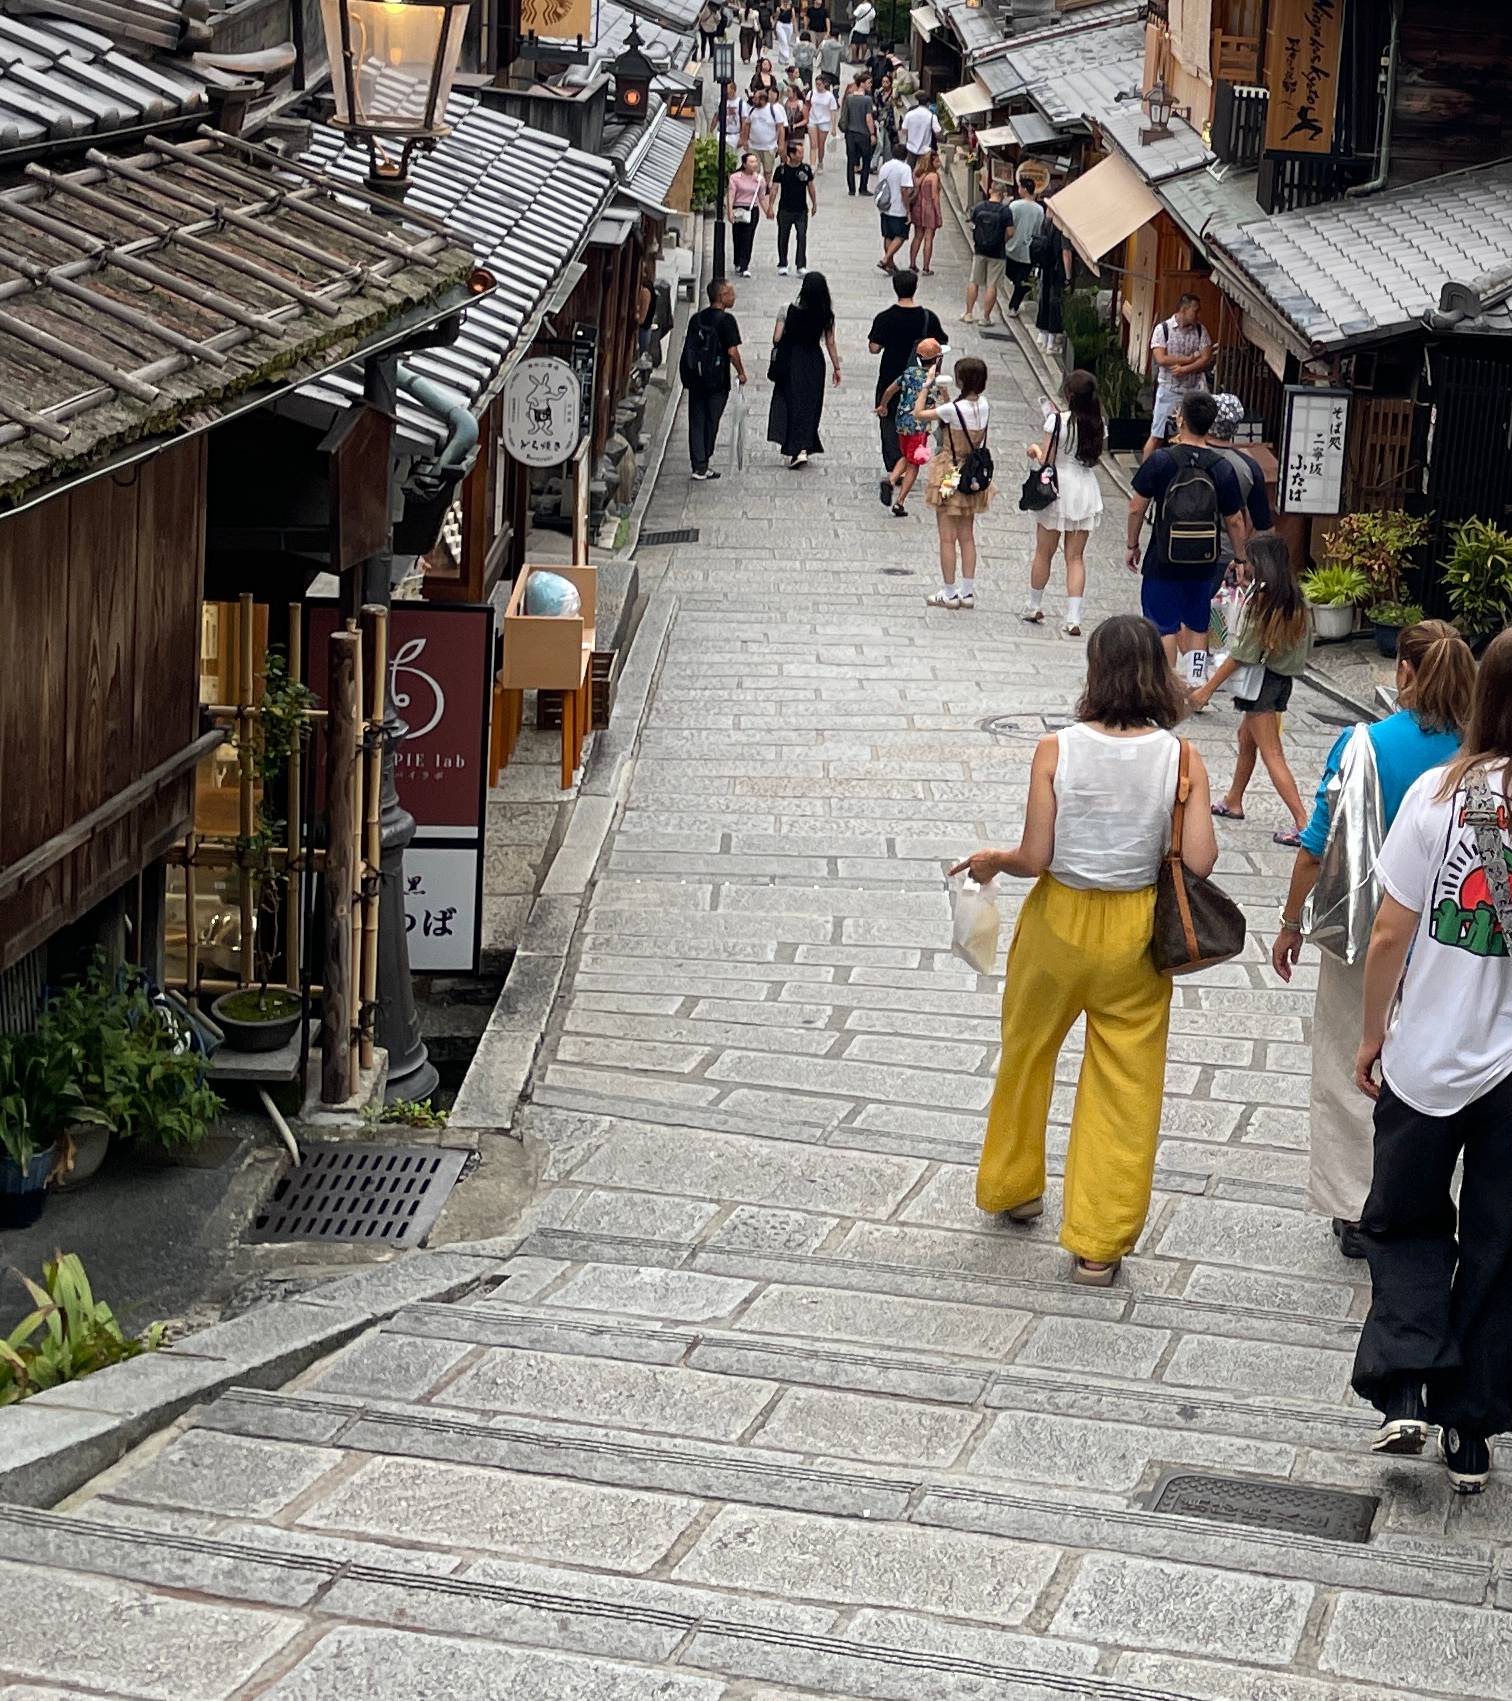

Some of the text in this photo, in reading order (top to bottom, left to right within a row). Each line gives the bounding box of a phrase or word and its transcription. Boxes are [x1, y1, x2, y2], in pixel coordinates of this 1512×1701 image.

[1328, 406, 1342, 451] そば処
[1289, 454, 1308, 502] ふたば
[393, 752, 465, 769] PIE lab
